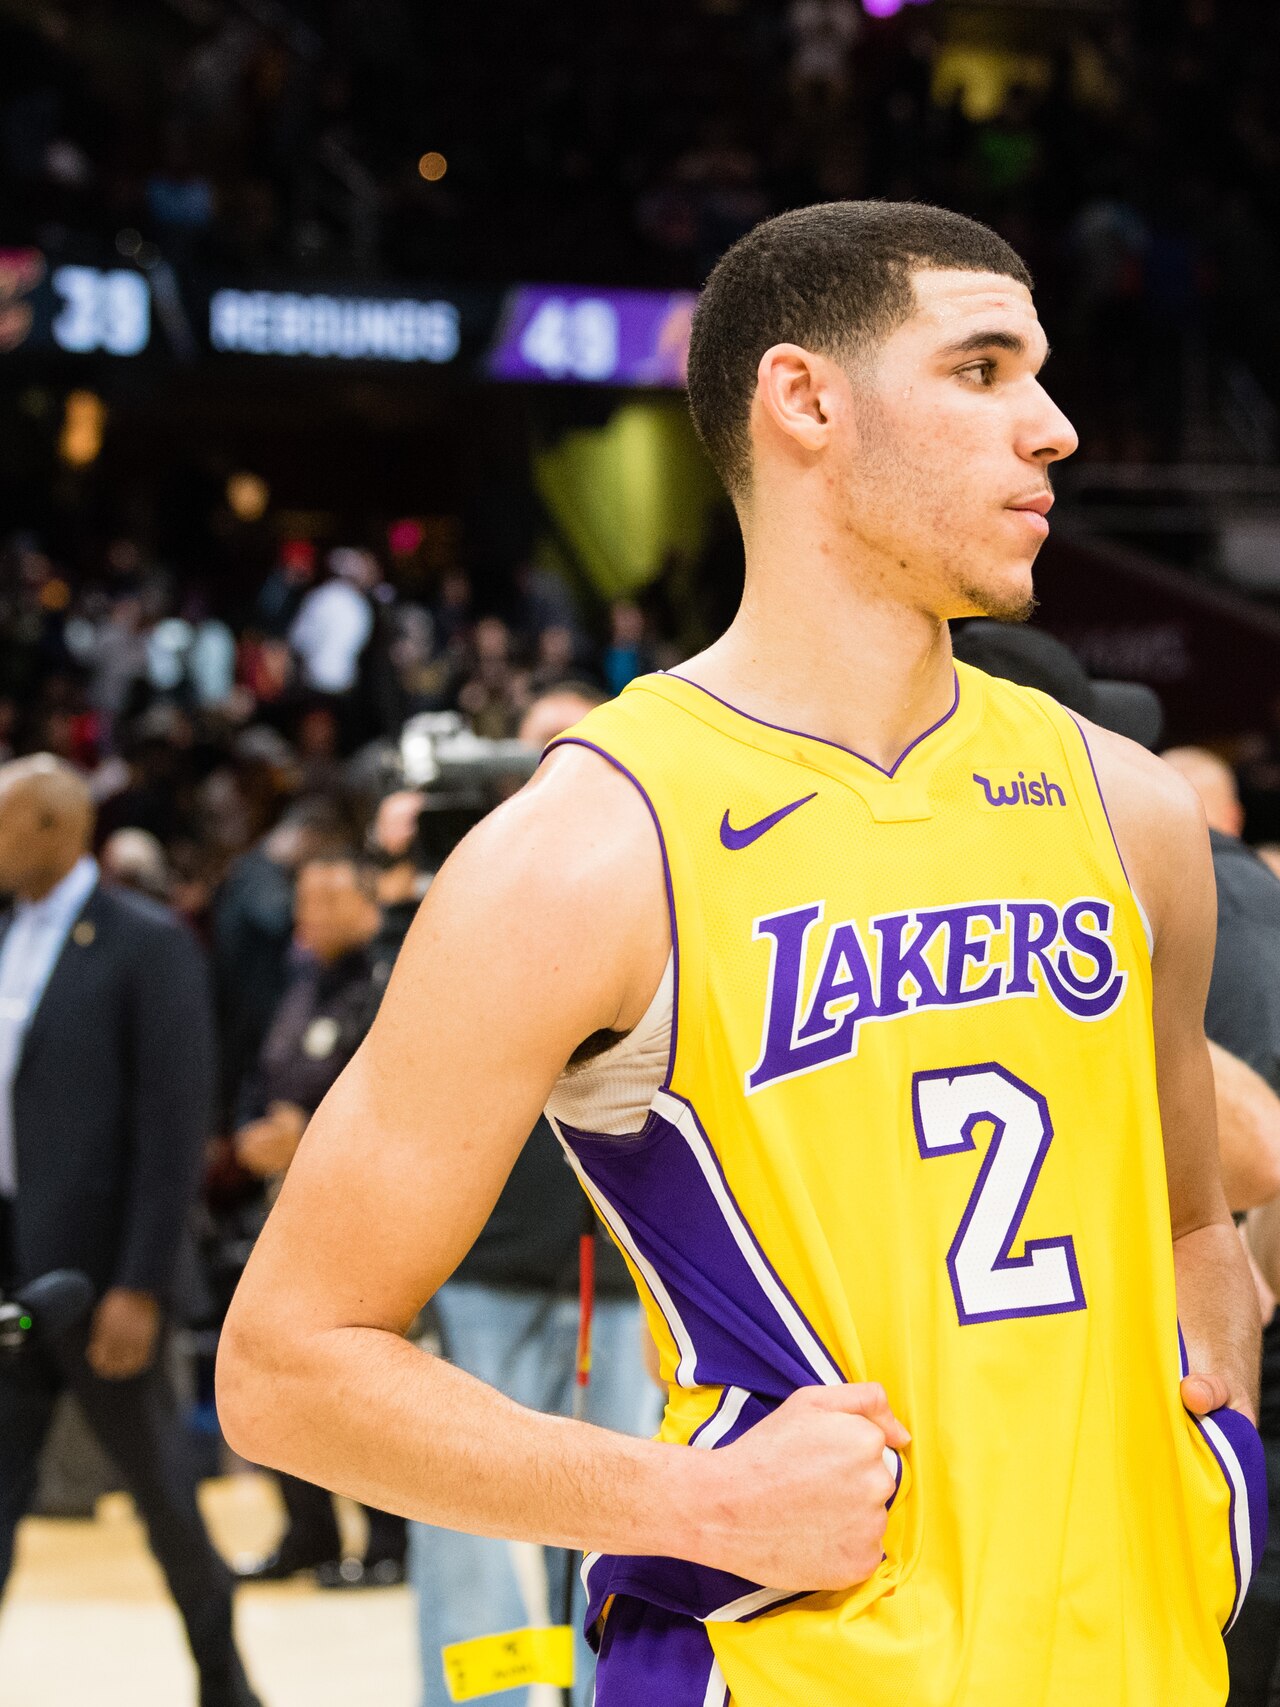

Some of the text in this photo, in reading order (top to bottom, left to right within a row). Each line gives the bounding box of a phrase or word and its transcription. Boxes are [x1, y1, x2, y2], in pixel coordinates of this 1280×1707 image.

[52, 266, 150, 356] 39
[210, 289, 459, 362] REBOUNDS
[519, 297, 619, 380] 49
[973, 771, 1066, 807] wish
[744, 896, 1128, 1096] LAKERS
[911, 1061, 1087, 1326] 2
